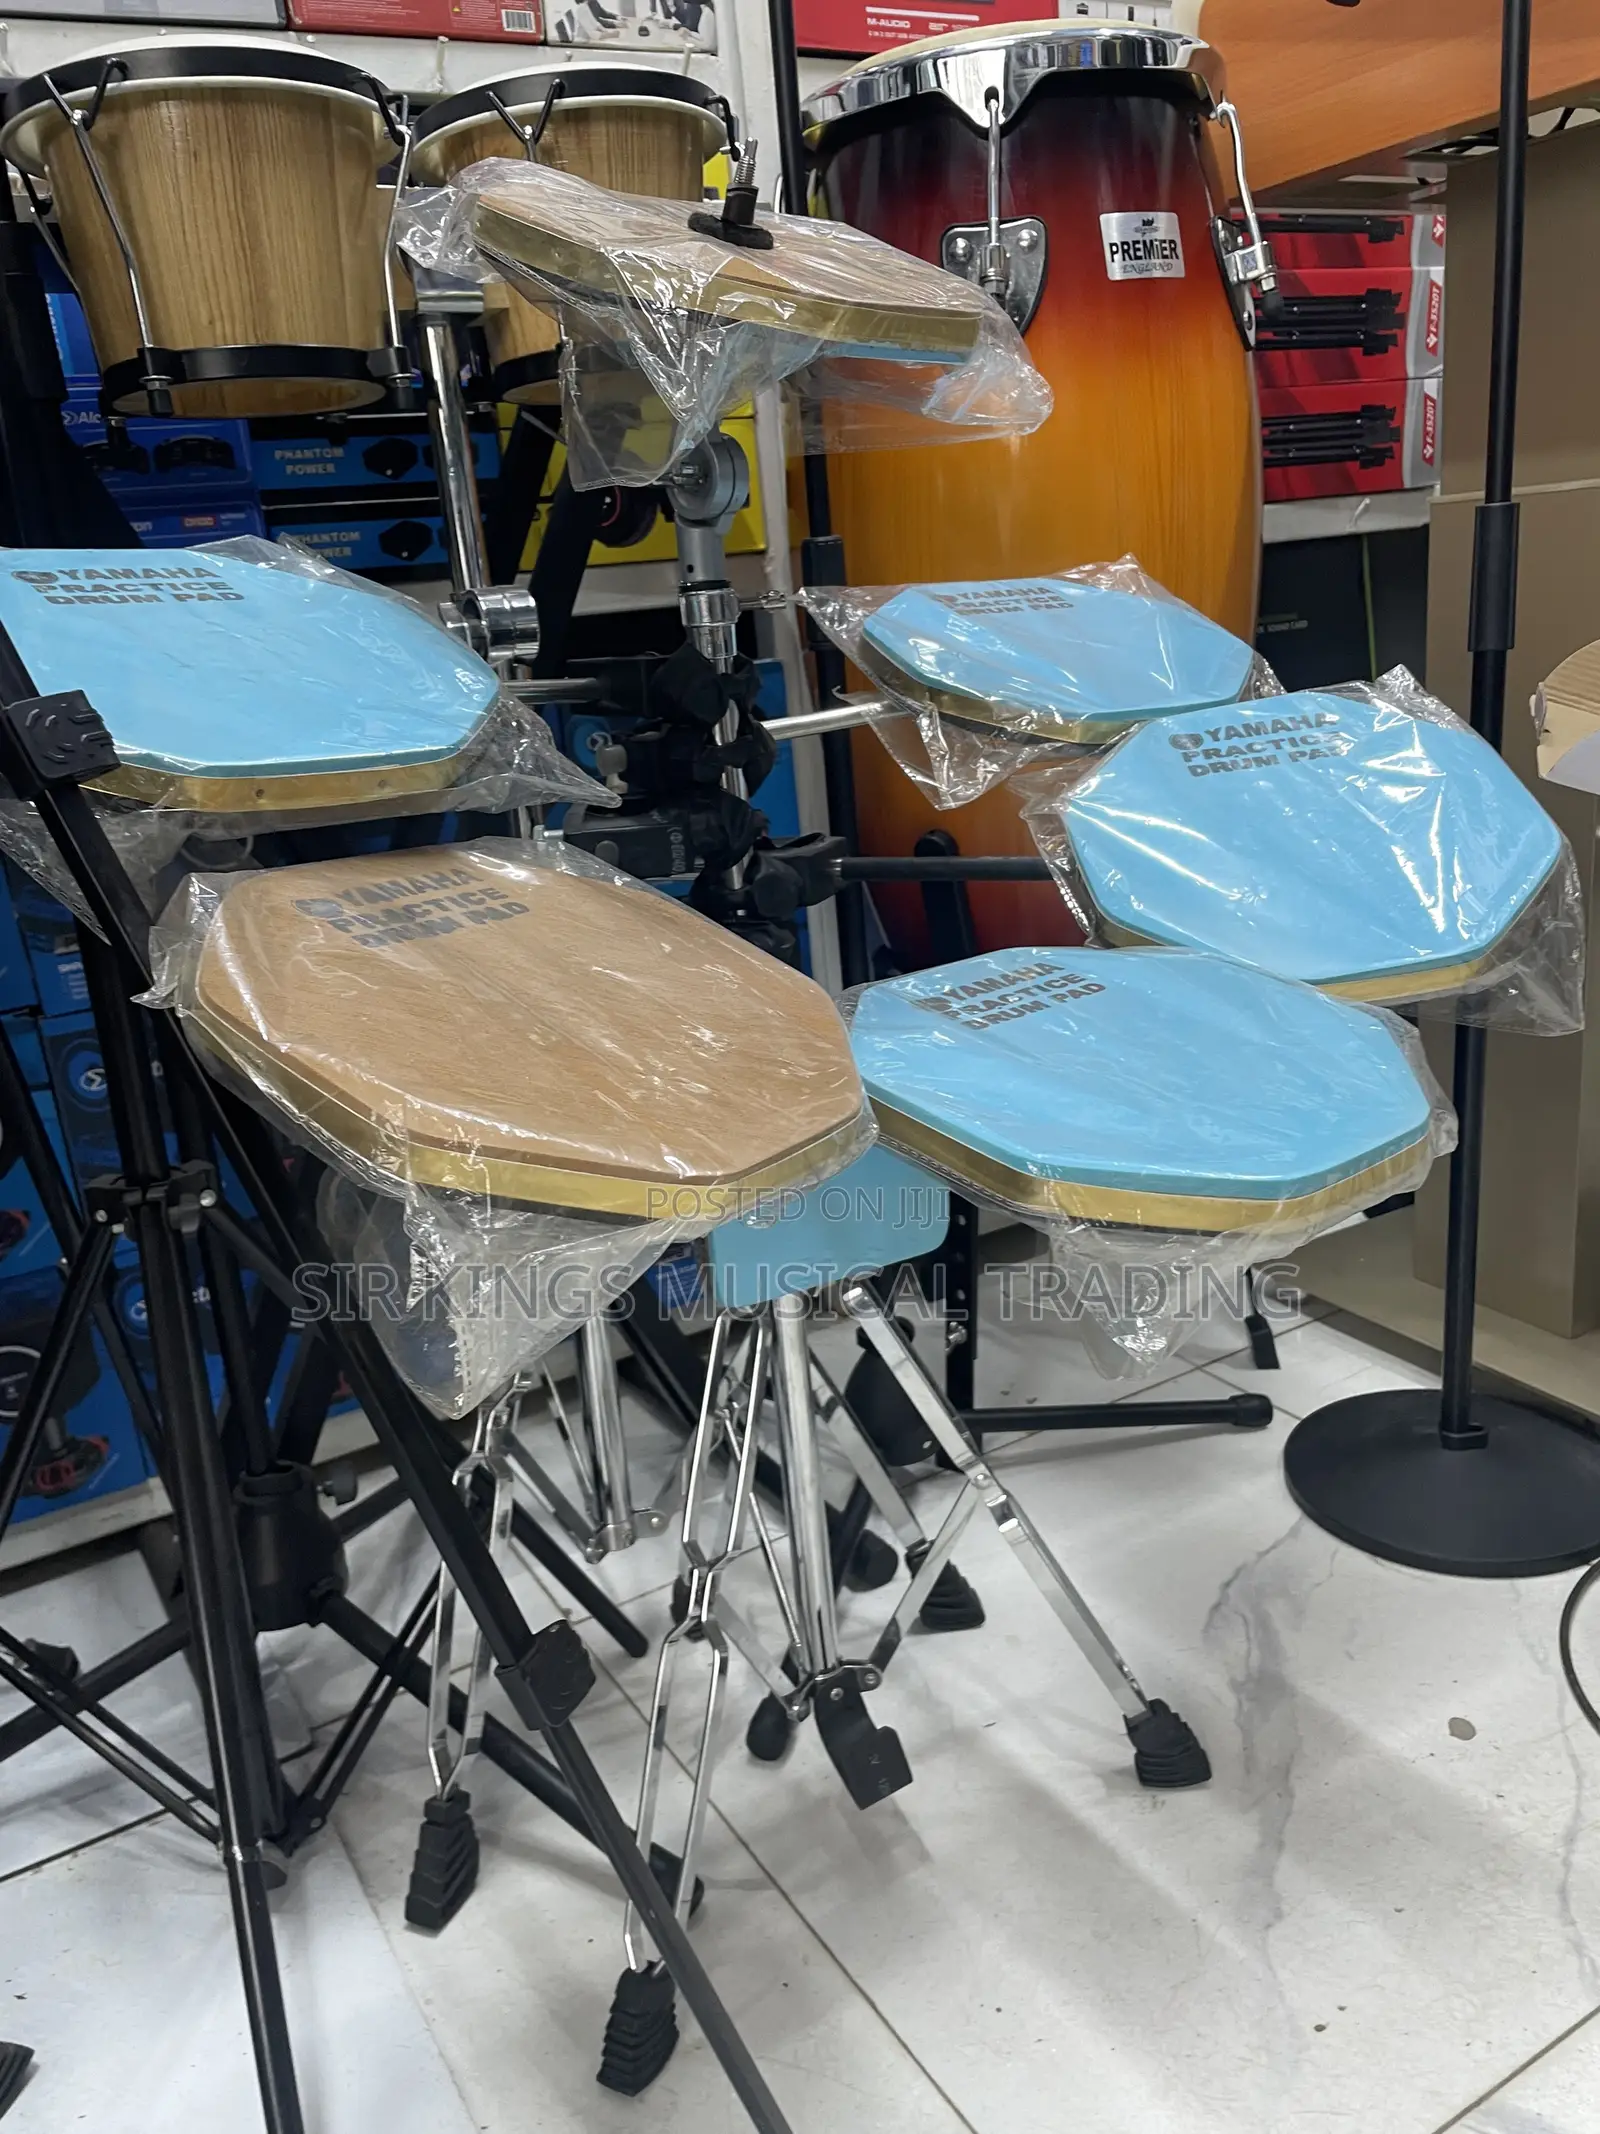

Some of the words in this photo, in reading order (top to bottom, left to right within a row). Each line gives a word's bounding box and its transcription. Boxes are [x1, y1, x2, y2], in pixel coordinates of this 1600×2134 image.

[866, 17, 911, 29] M-AUDIO
[1122, 261, 1174, 275] ENGLAND
[274, 447, 345, 460] PHANTOM
[286, 463, 336, 475] POWER
[57, 567, 221, 581] YAMAHA
[32, 581, 234, 594] PRACTICE
[956, 586, 1056, 600] YAMAHA
[44, 594, 165, 605] DRUM
[169, 592, 245, 603] PAD
[1028, 602, 1075, 611] PAD
[1204, 712, 1339, 742] YAMAHA
[1188, 754, 1280, 777] DRUM
[334, 868, 484, 907] YAMAHA
[327, 887, 509, 934] PRACTICE
[352, 916, 465, 949] DRUM
[460, 901, 530, 925] PAD
[942, 962, 1065, 999] YAMAHA
[941, 973, 1087, 1020] PRACTICE
[961, 1000, 1051, 1031] DRUM
[1048, 983, 1107, 1004] PAD
